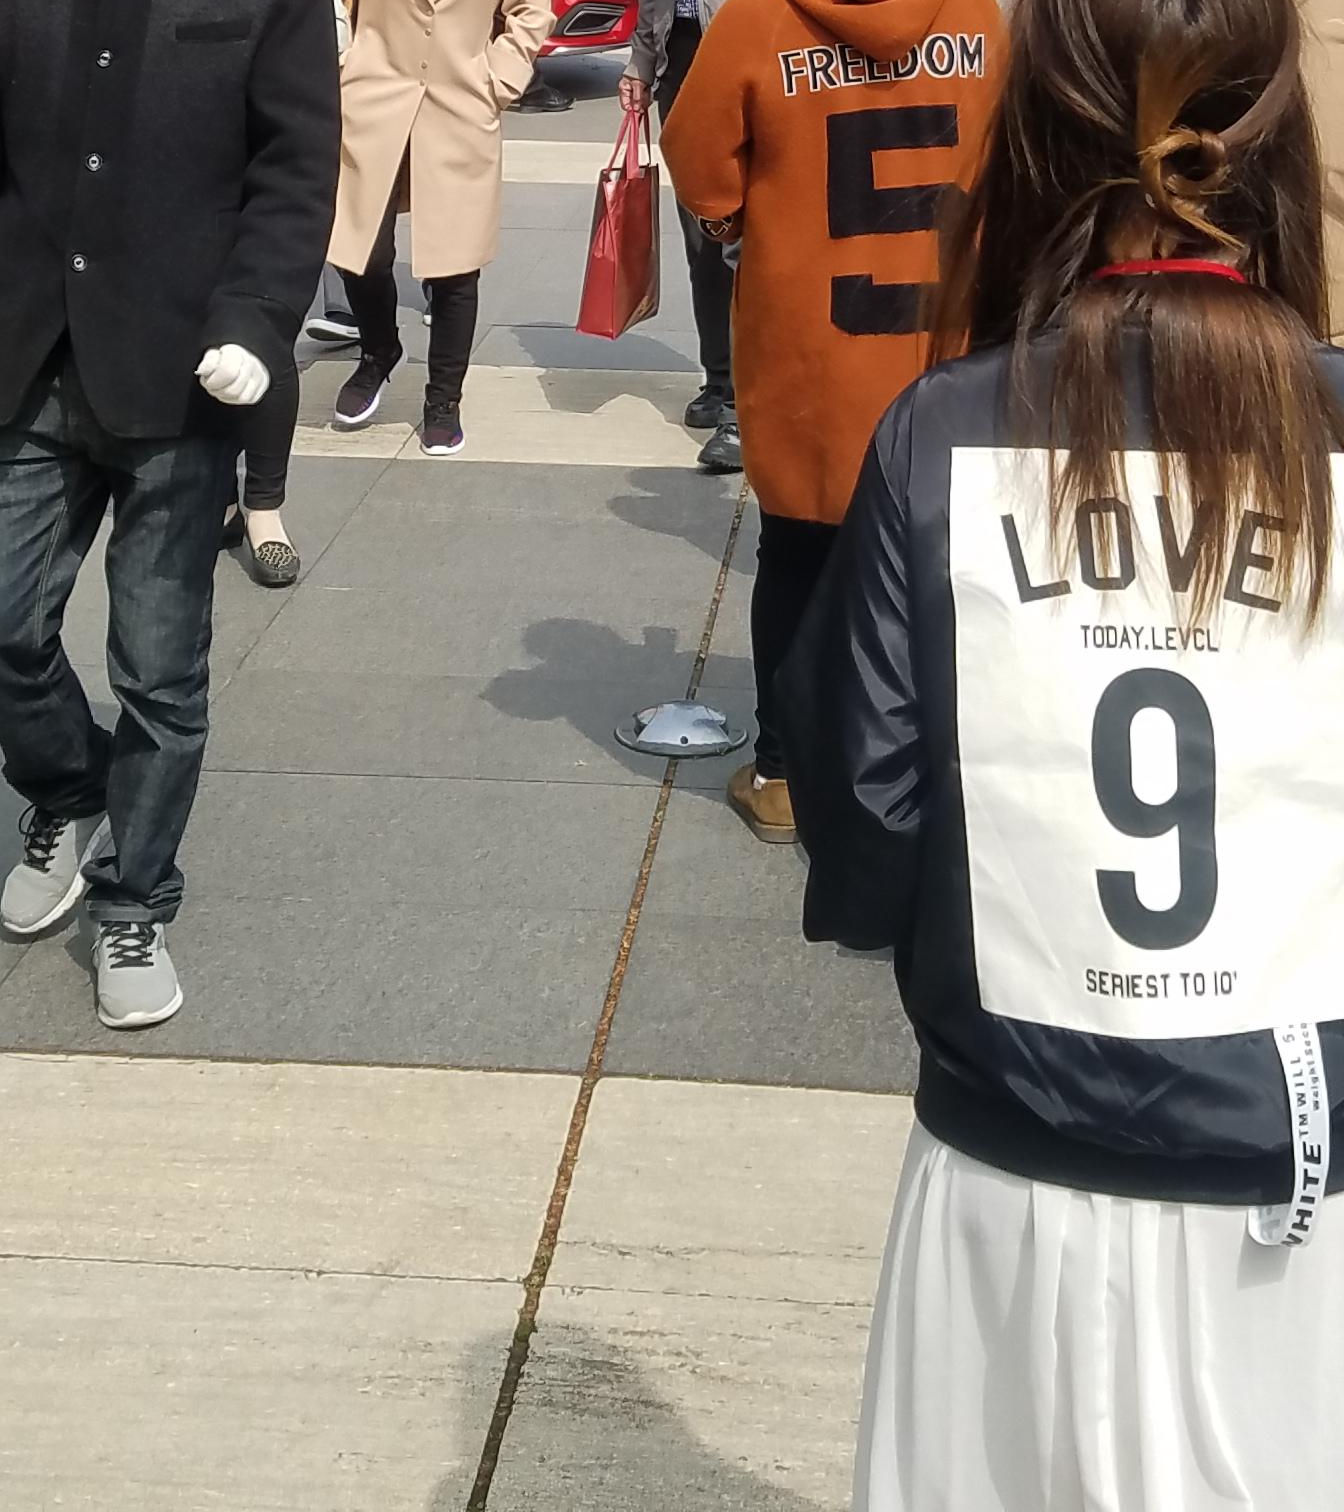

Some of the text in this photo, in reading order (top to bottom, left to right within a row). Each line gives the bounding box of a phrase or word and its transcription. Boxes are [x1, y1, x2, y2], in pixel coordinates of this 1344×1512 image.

[826, 103, 959, 336] 5
[1001, 495, 1299, 613] LOVE
[1091, 667, 1218, 950] 9
[1086, 968, 1170, 999] SERIEST
[1180, 972, 1205, 997] TO
